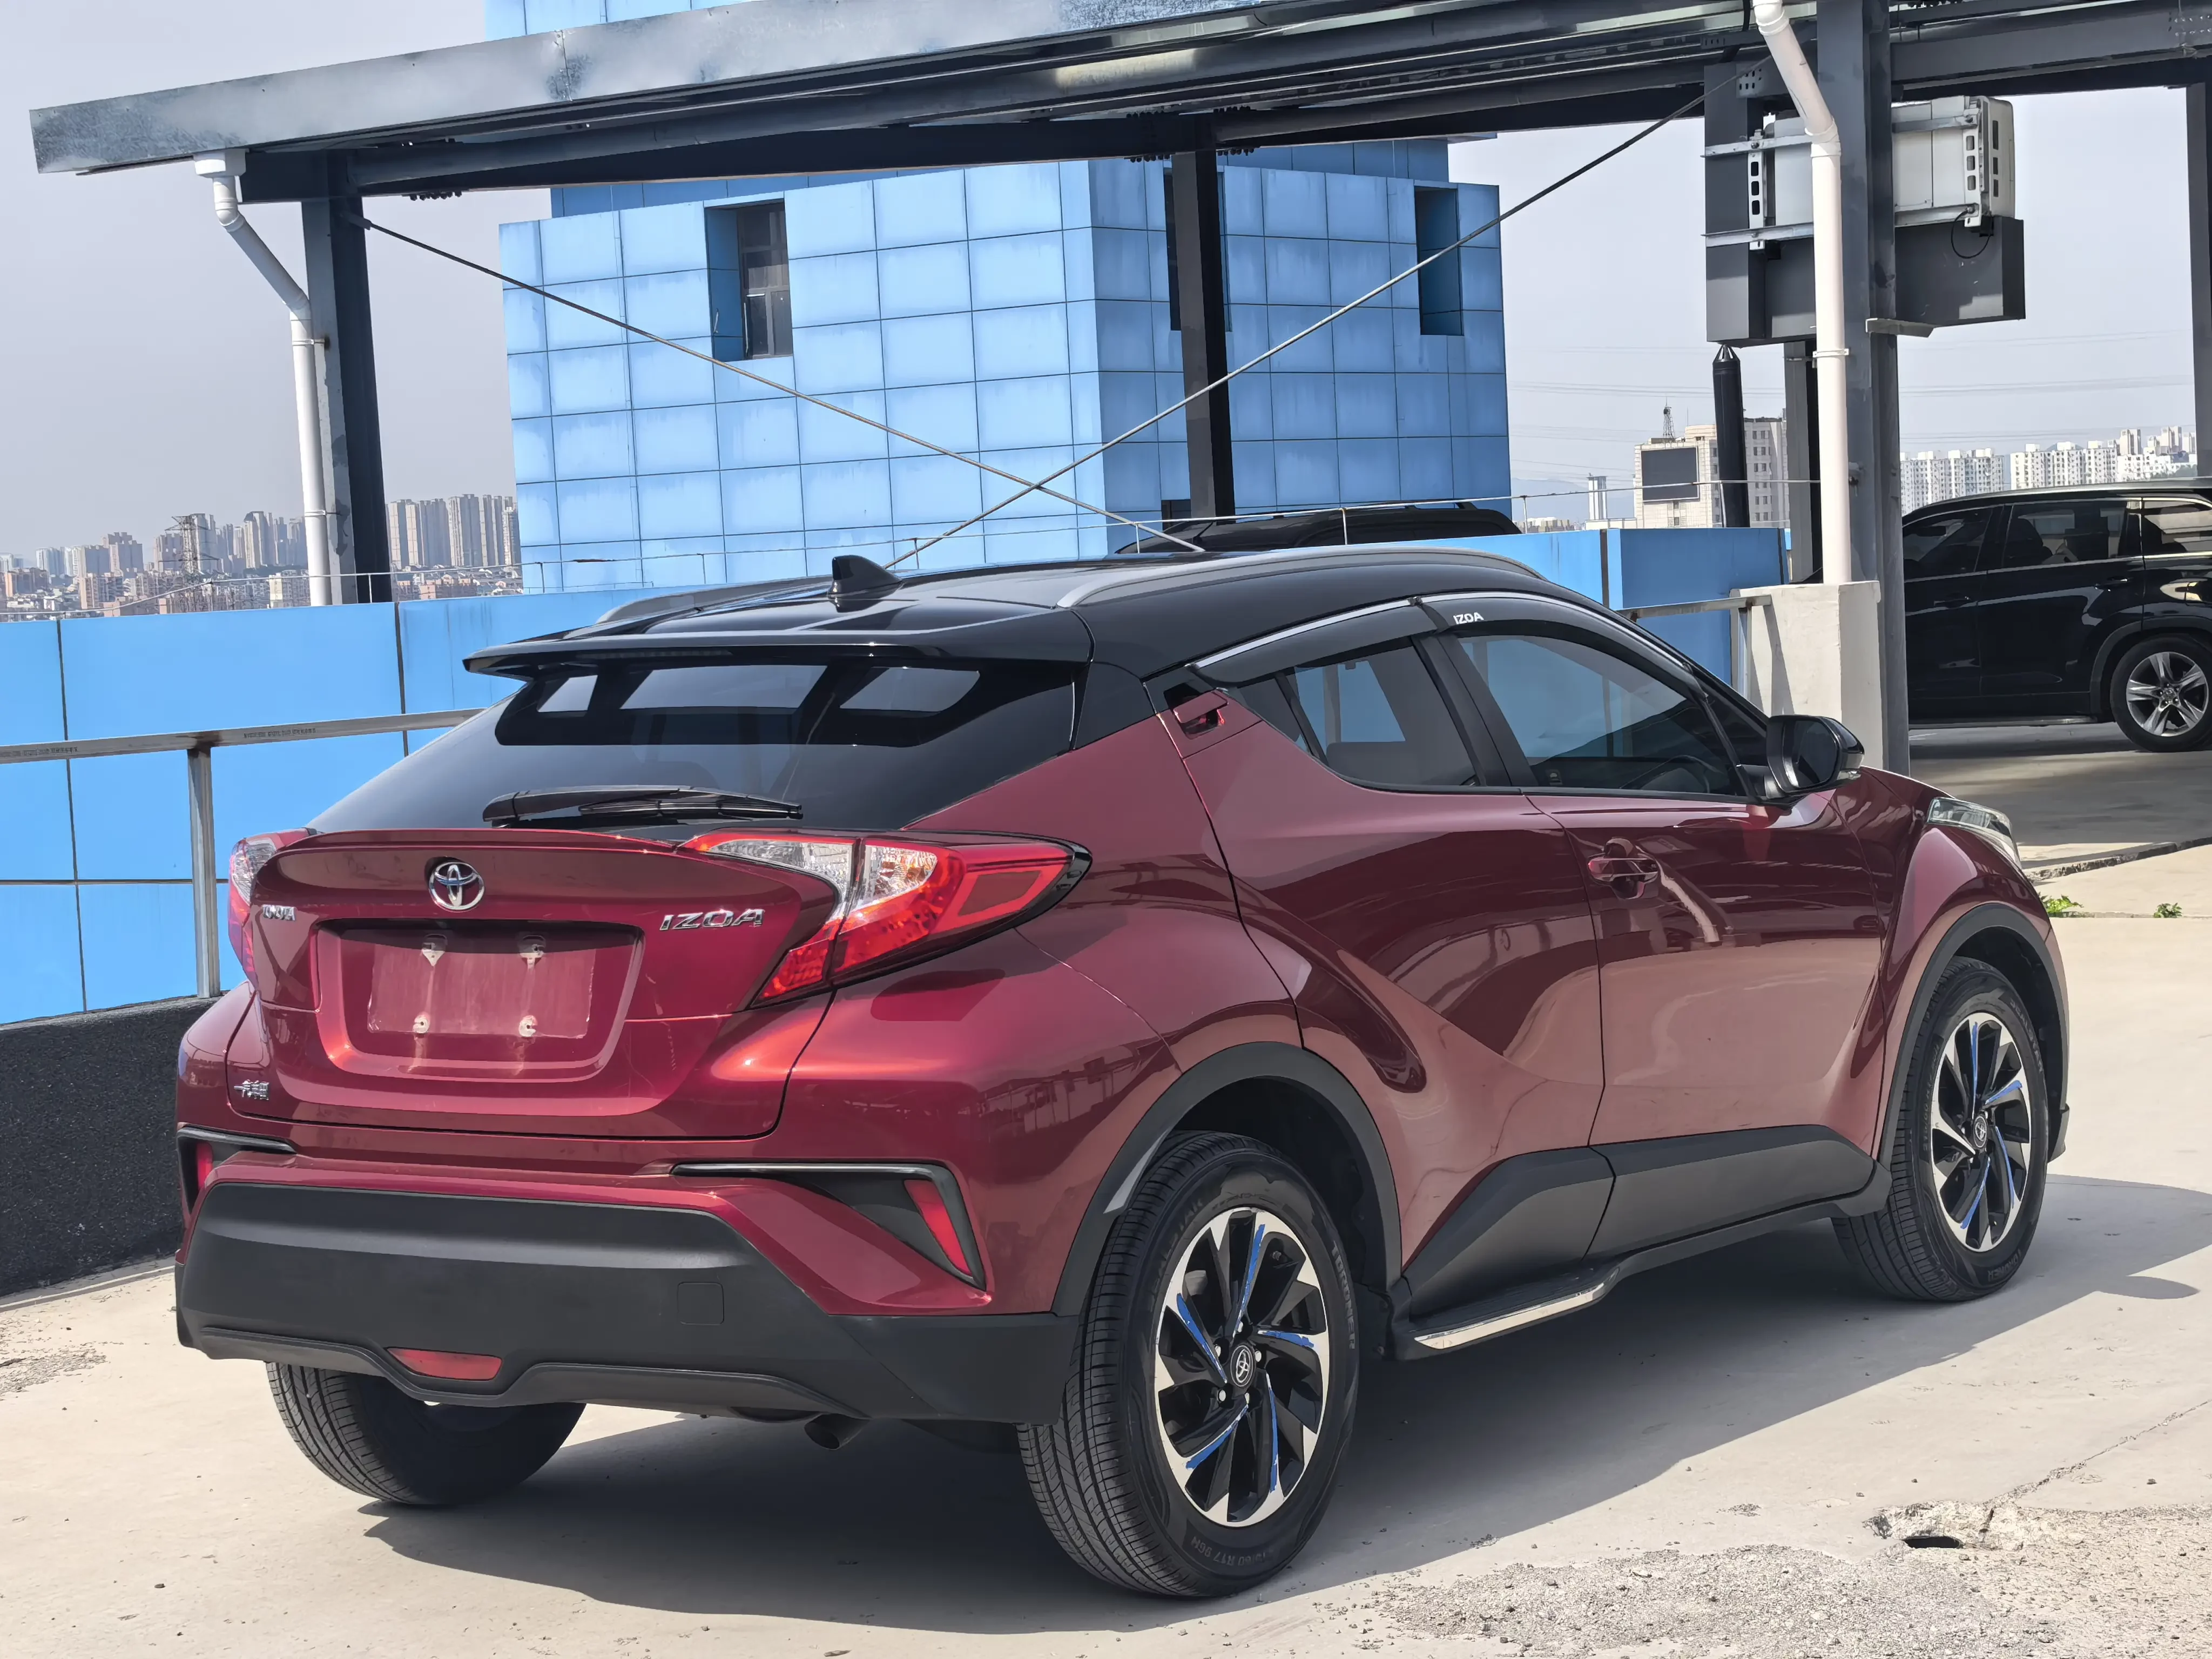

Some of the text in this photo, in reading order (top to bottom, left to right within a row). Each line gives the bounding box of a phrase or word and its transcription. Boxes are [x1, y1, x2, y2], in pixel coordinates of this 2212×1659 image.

[1453, 611, 1484, 625] IZOA
[659, 908, 766, 931] IZOA
[233, 1079, 269, 1101] 一汽丰田
